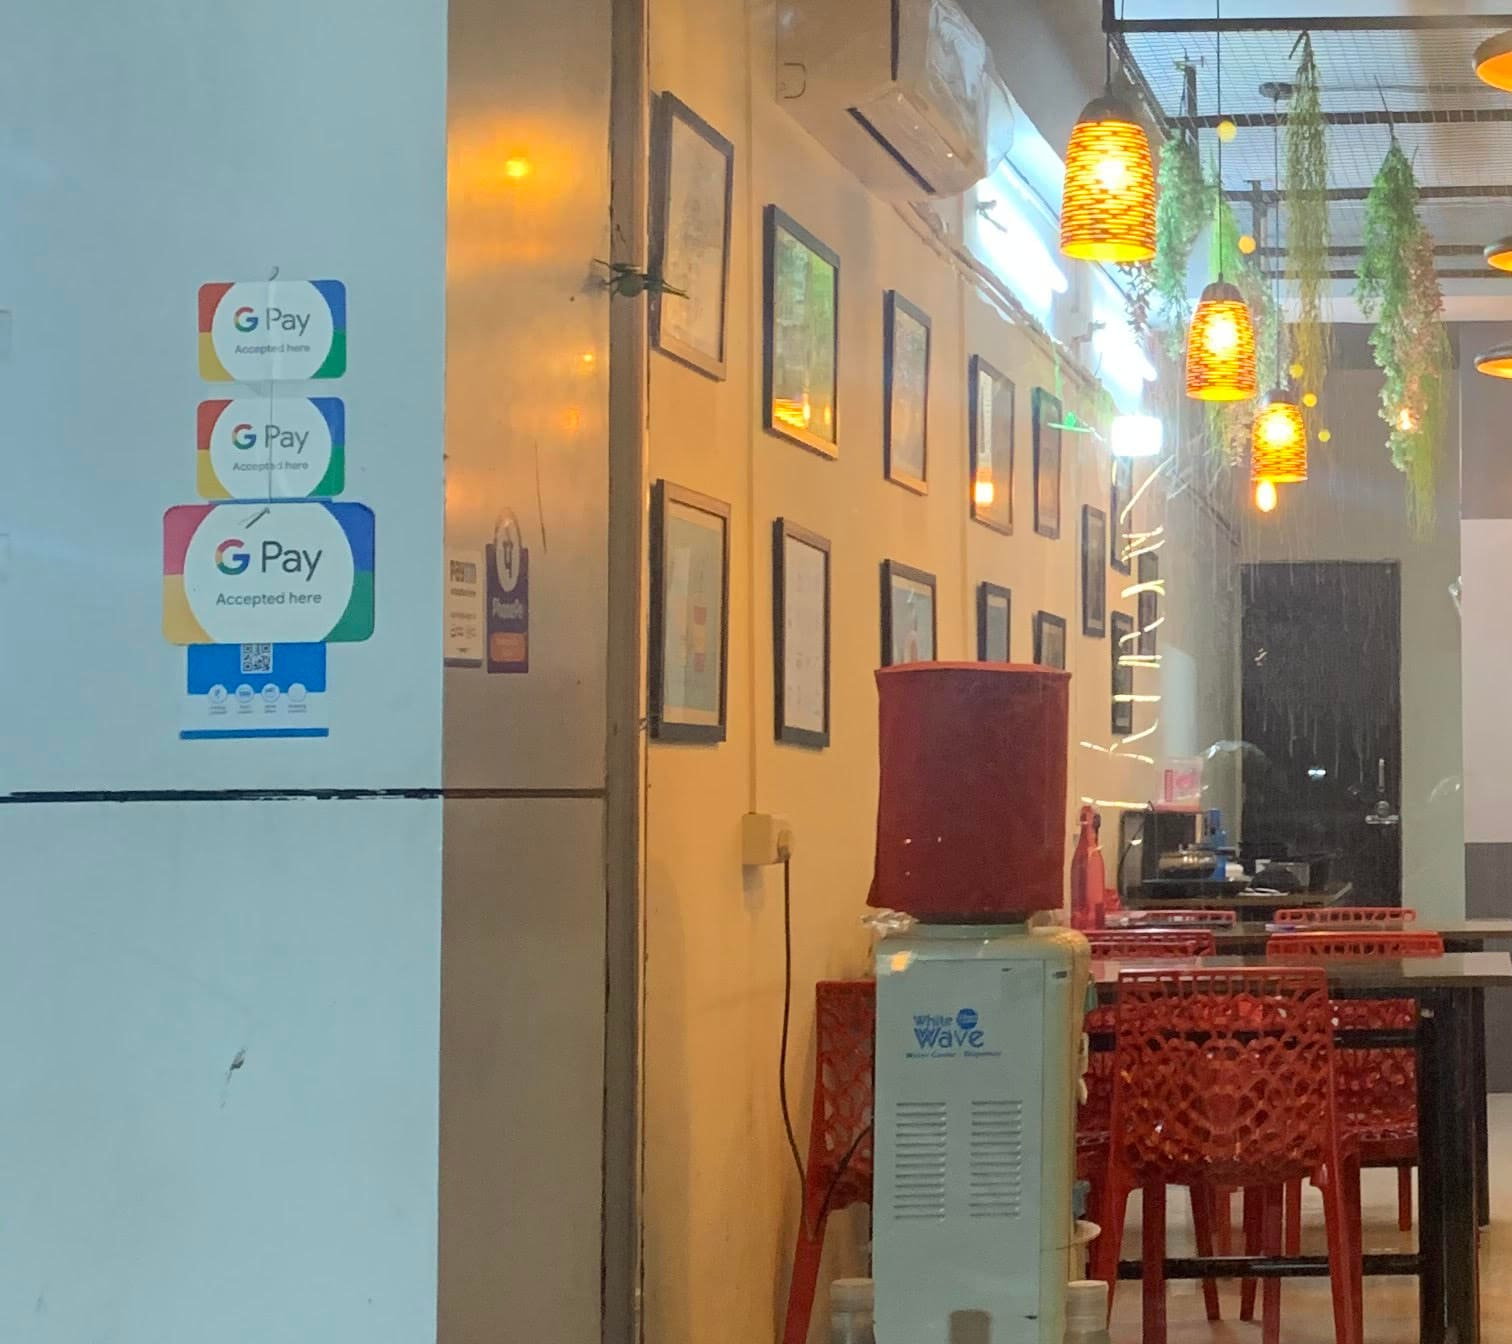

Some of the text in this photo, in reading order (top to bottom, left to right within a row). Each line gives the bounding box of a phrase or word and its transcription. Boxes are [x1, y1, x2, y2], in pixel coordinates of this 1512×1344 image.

[233, 306, 311, 337] G Pay
[234, 343, 311, 355] Accepted here
[231, 423, 310, 455] G Pay
[284, 461, 310, 470] here
[214, 538, 323, 582] G Pay
[215, 592, 323, 607] Accepted here
[913, 1026, 985, 1049] Wave
